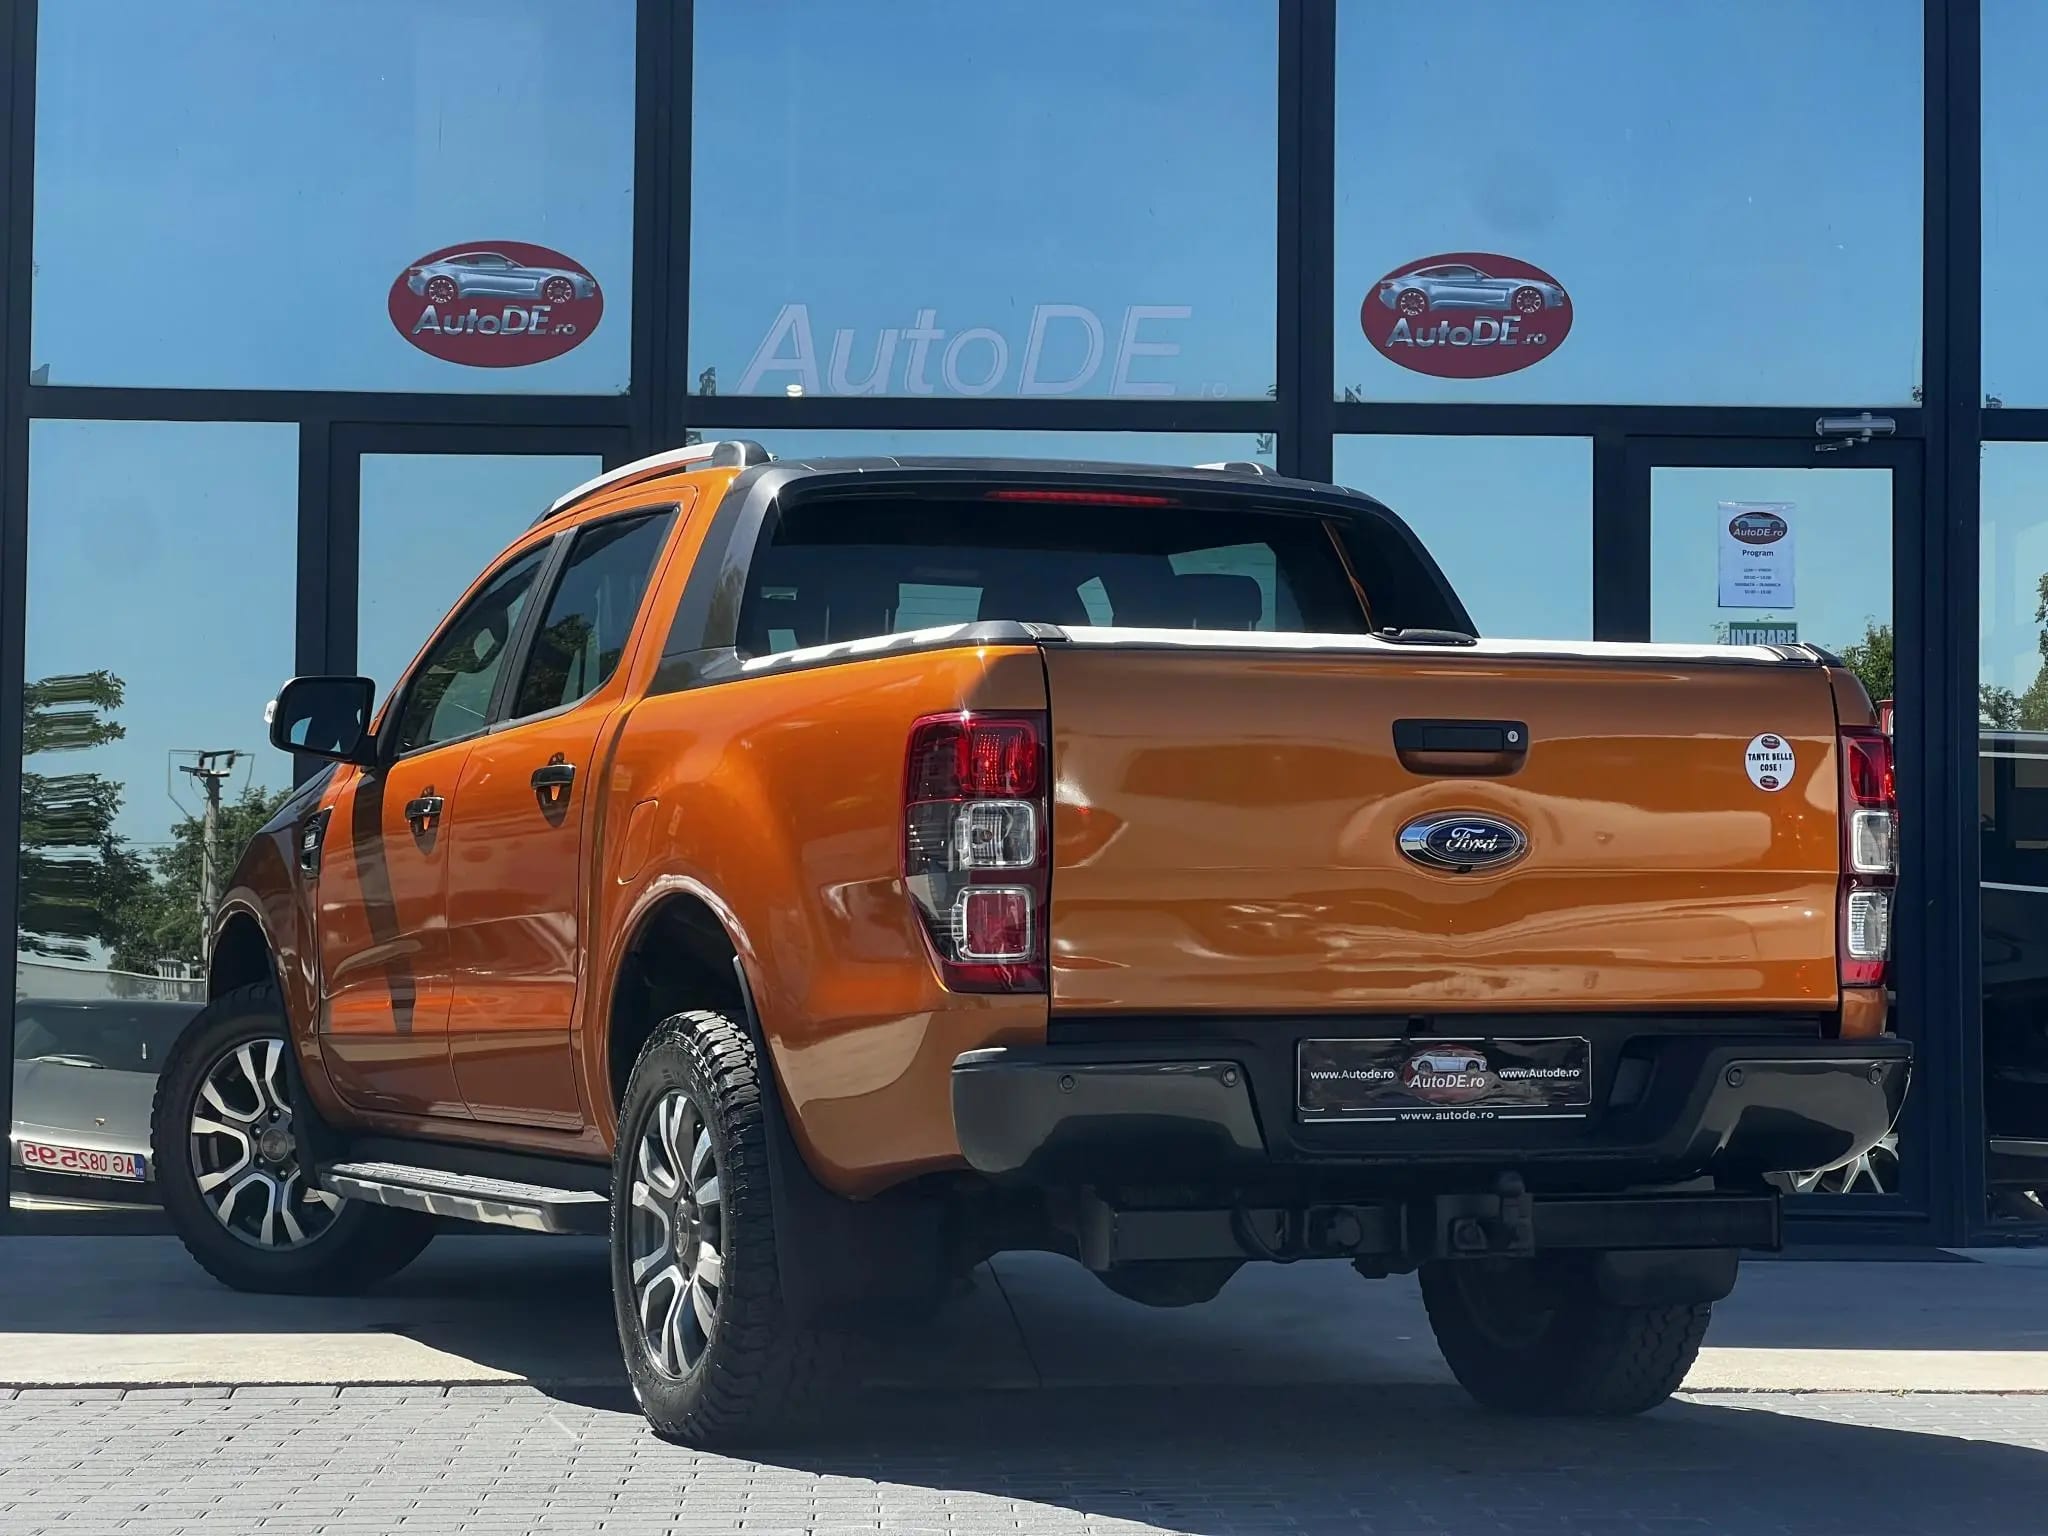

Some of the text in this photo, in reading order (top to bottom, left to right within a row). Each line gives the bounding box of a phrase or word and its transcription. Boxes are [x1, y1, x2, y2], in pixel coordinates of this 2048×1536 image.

[1742, 549, 1774, 557] Program
[1748, 753, 1793, 761] TANTE BELLE
[1445, 827, 1499, 852] Ford
[1310, 1068, 1395, 1081] www.Autode.ro
[1499, 1067, 1580, 1079] www.Autode.ro
[1409, 1073, 1486, 1089] AutoDE.ro
[1400, 1109, 1495, 1121] www.autode.ro
